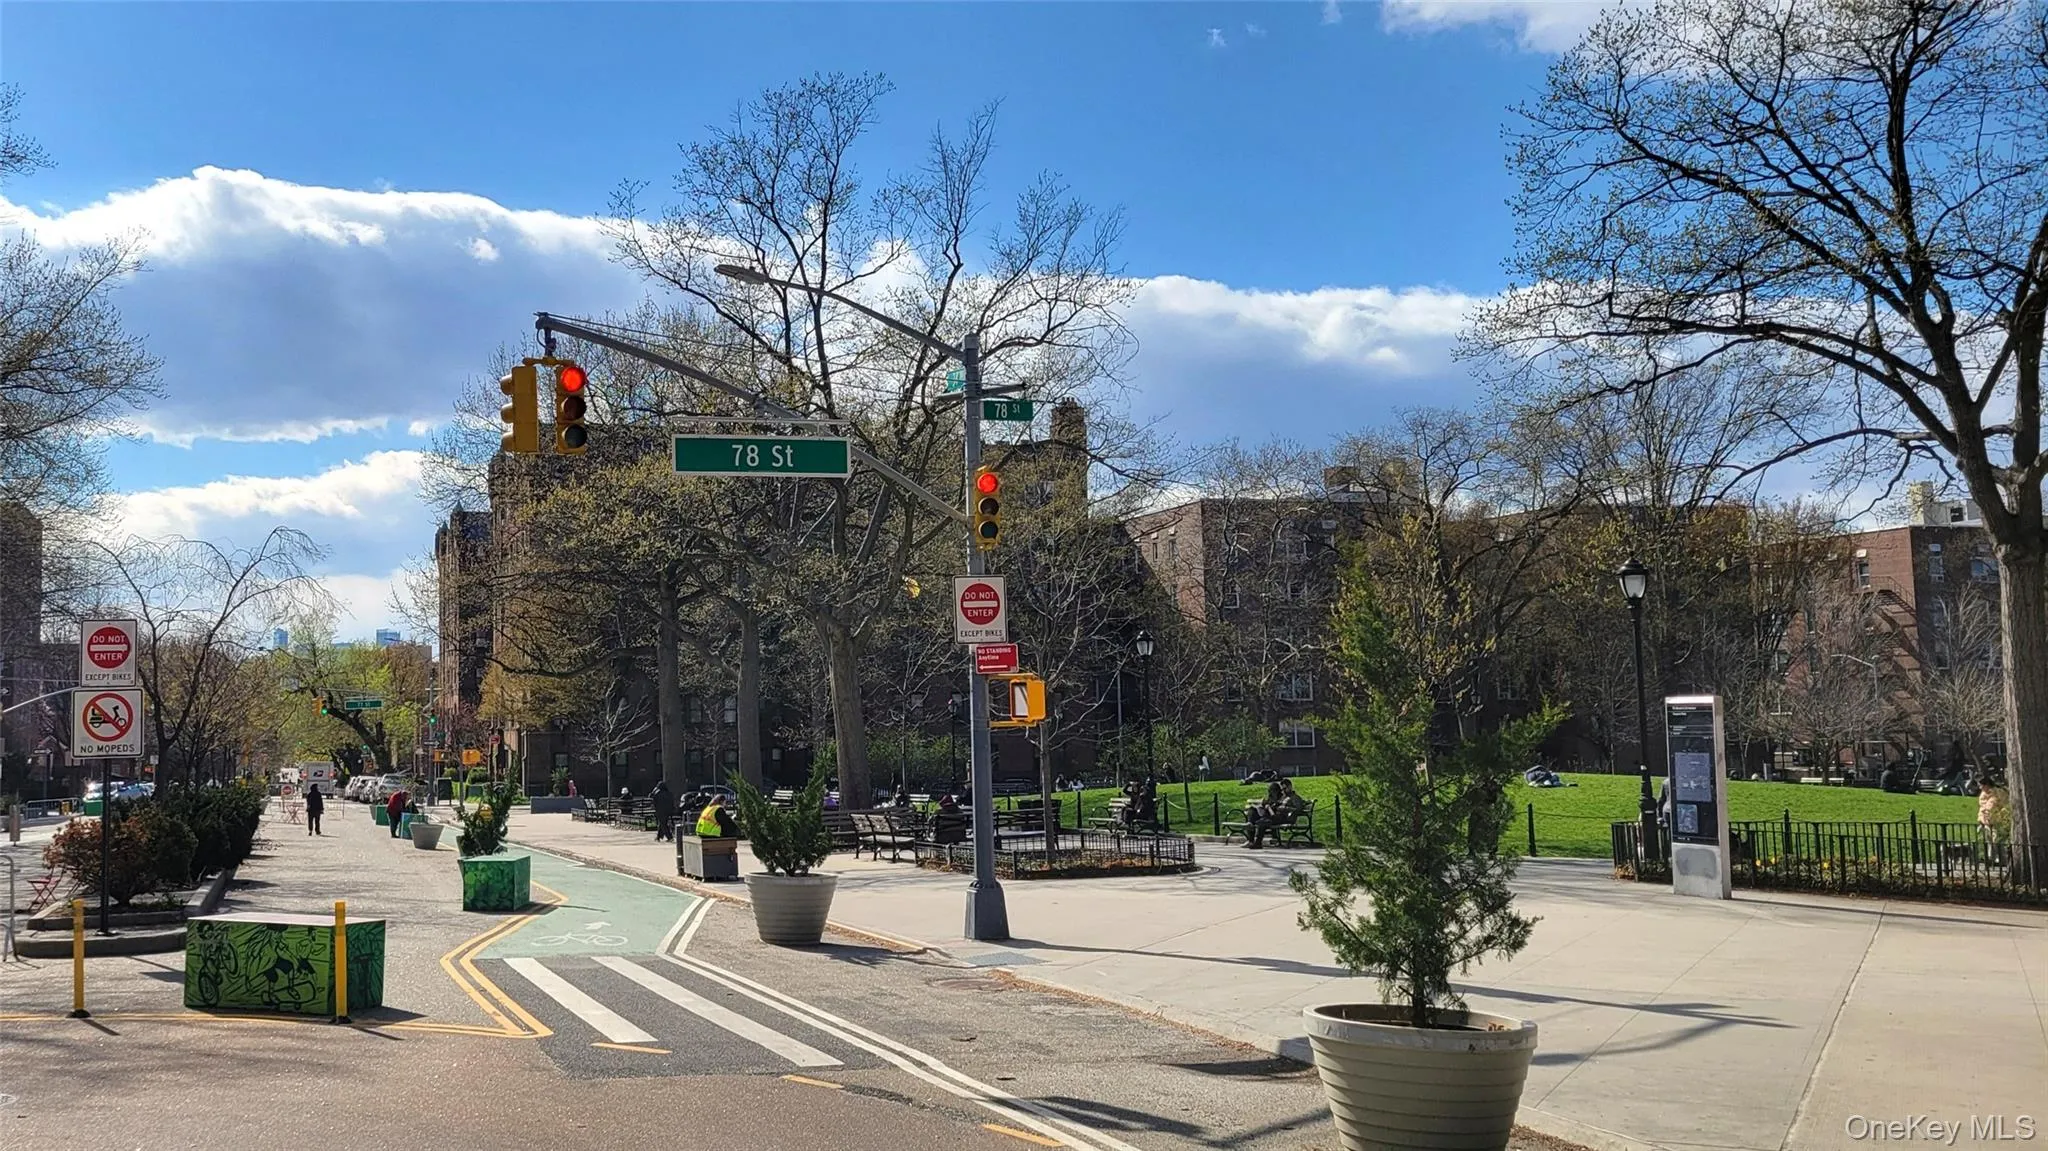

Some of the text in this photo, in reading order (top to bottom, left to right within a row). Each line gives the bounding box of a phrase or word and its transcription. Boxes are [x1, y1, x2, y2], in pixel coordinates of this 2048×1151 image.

[994, 403, 1021, 418] 78 St
[731, 444, 794, 468] 78 St
[964, 591, 995, 600] DO NOT
[967, 608, 994, 617] ENTER
[960, 629, 1003, 638] EXCEPT BIKES
[92, 635, 126, 644] DO NOT
[94, 652, 123, 661] ENTER
[85, 673, 132, 681] EXCEPT BIKES
[80, 743, 135, 754] NO MOPEDS
